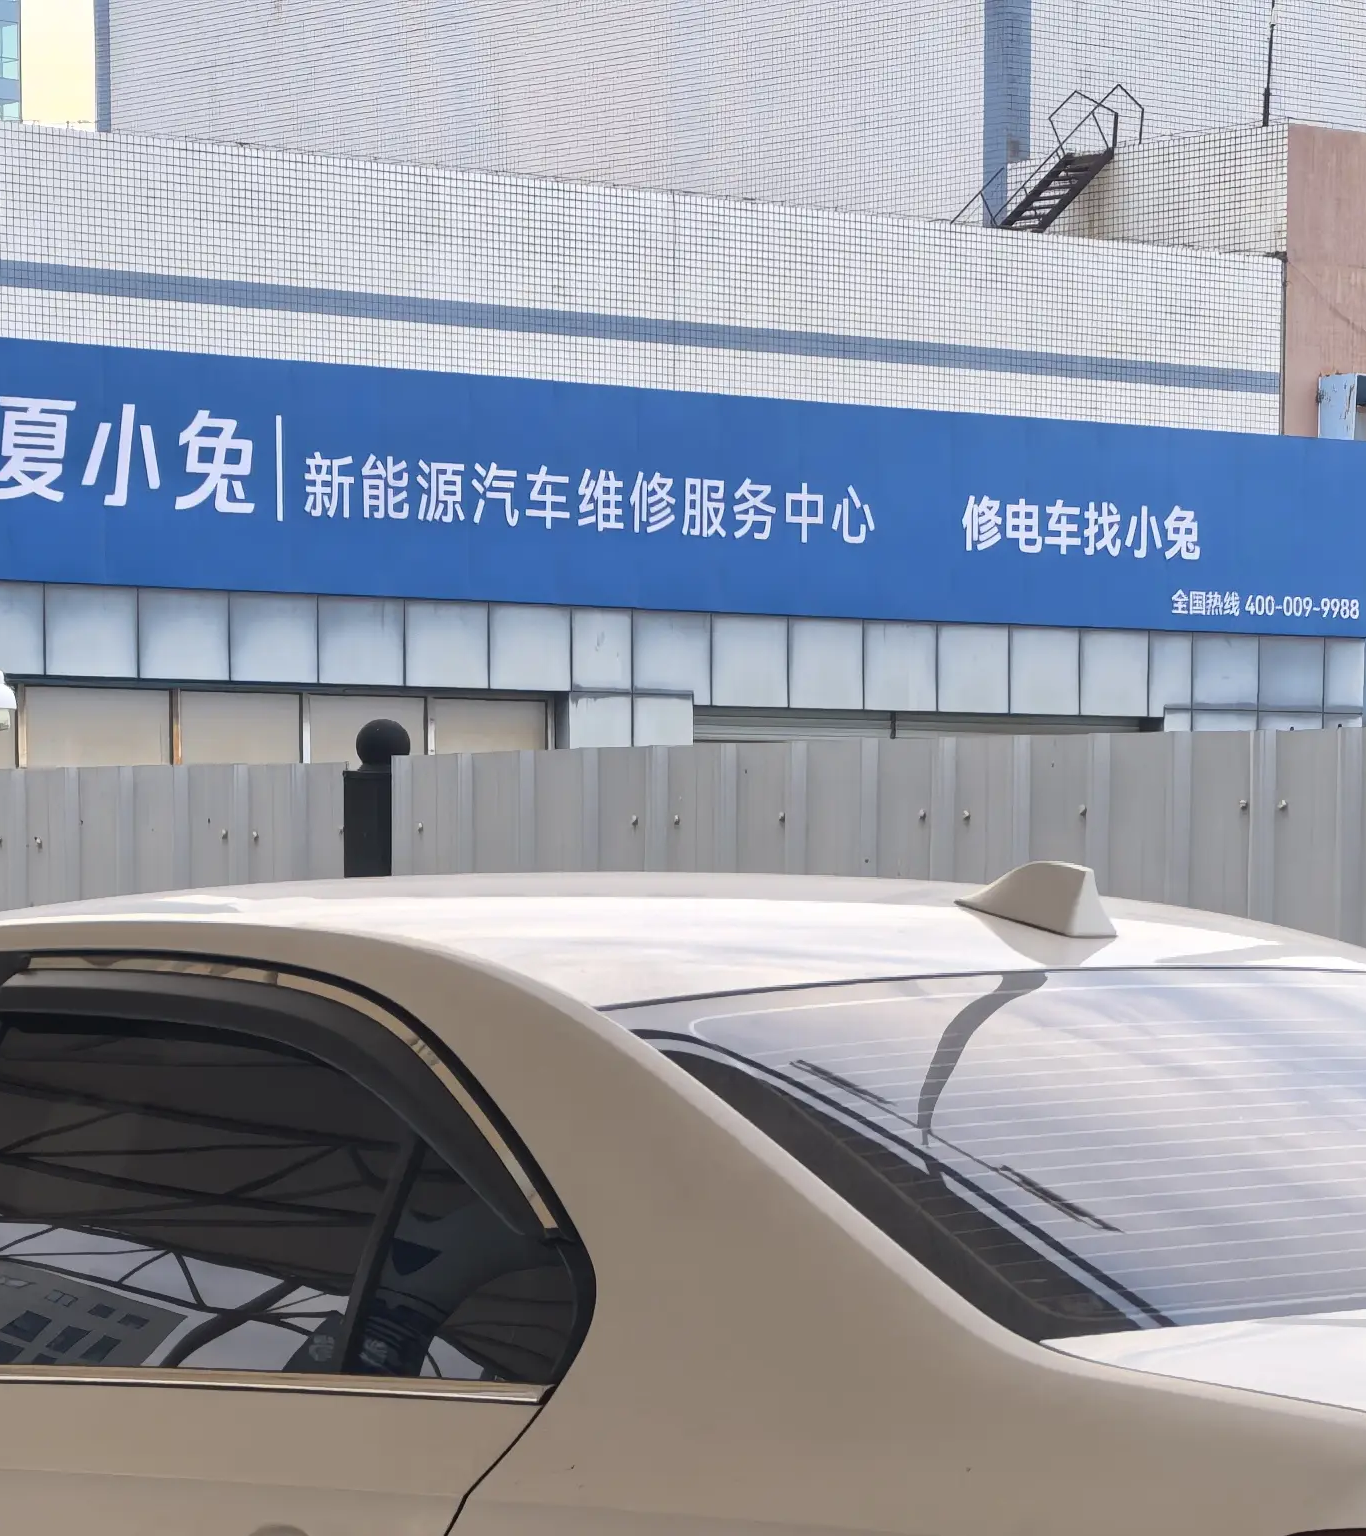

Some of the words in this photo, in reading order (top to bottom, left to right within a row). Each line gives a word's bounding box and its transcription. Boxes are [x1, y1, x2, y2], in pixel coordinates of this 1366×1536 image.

[303, 451, 875, 545] 新能源汽车维修服务中心
[961, 494, 1202, 561] 修电车找小兔
[1171, 588, 1241, 617] 全国热线
[1244, 594, 1361, 620] 400-009-9988
